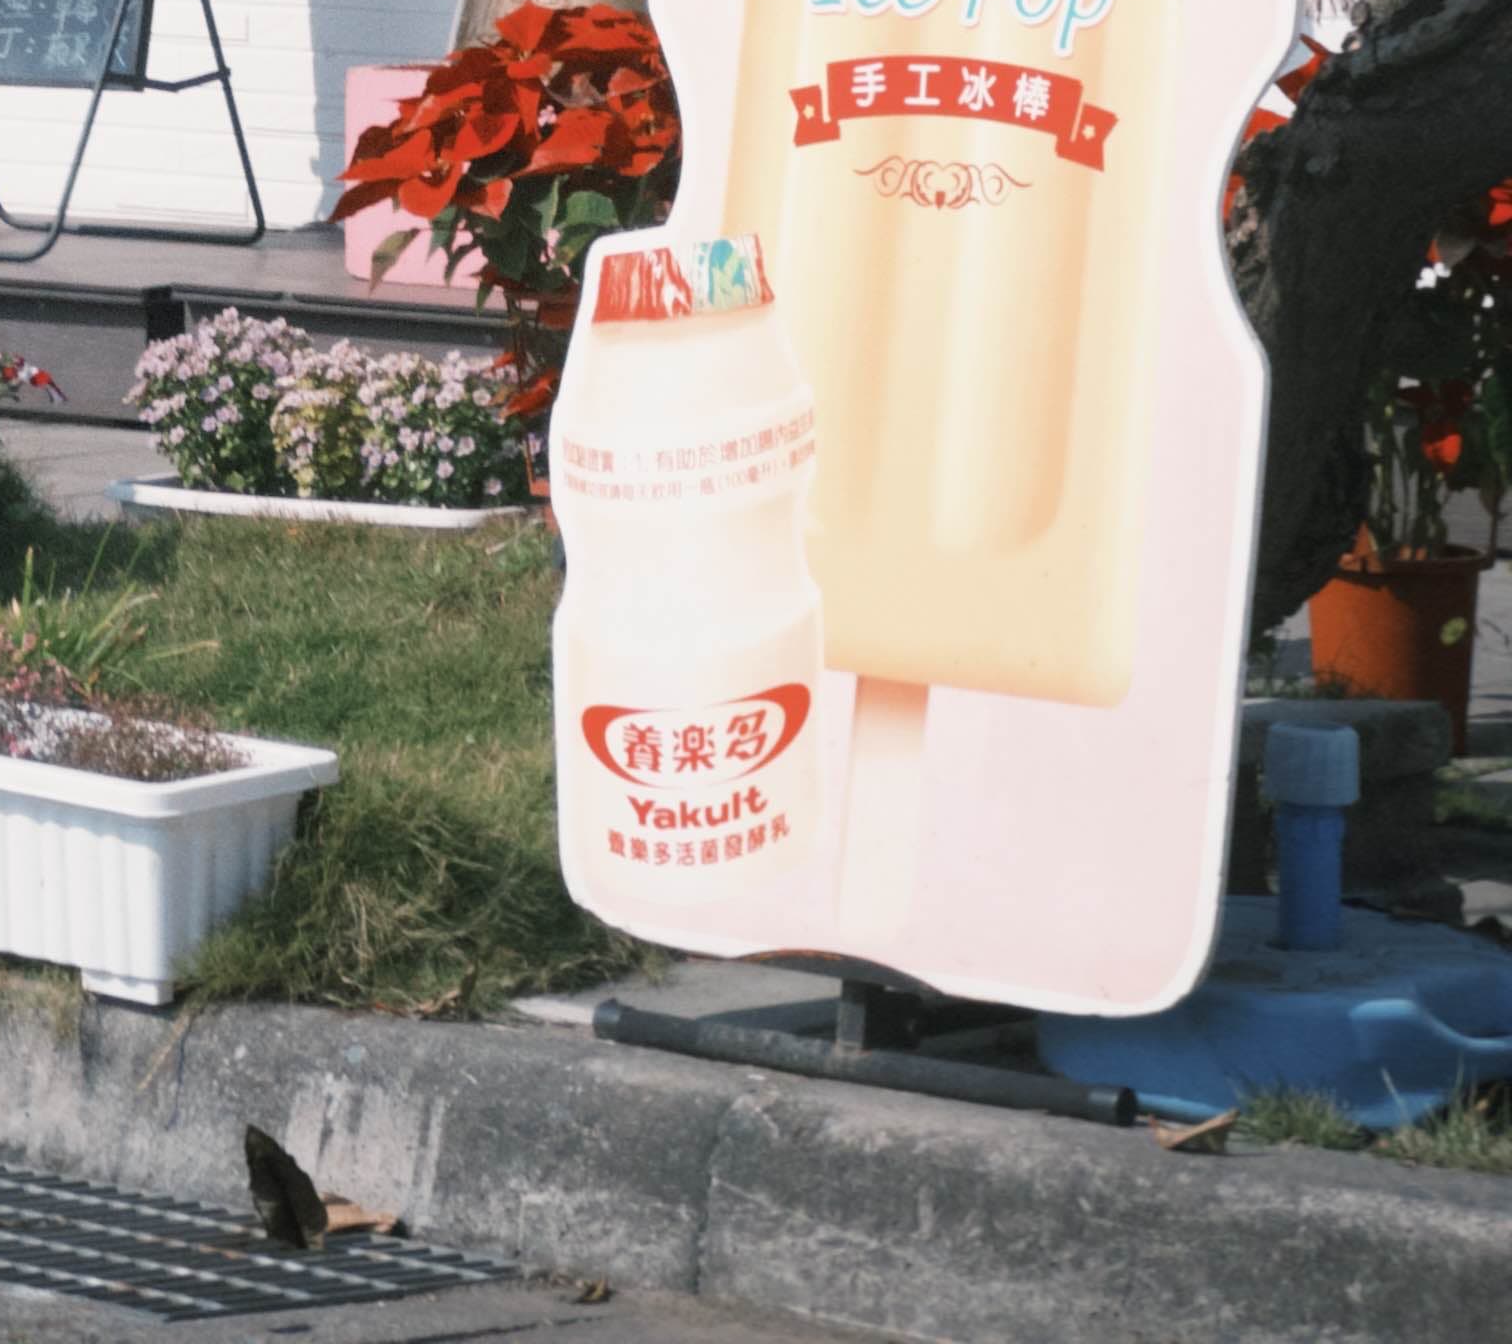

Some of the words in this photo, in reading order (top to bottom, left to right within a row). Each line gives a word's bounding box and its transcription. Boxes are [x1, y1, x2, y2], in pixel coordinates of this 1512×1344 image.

[850, 61, 1053, 122] 手工冰棒
[626, 784, 769, 830] Yakult
